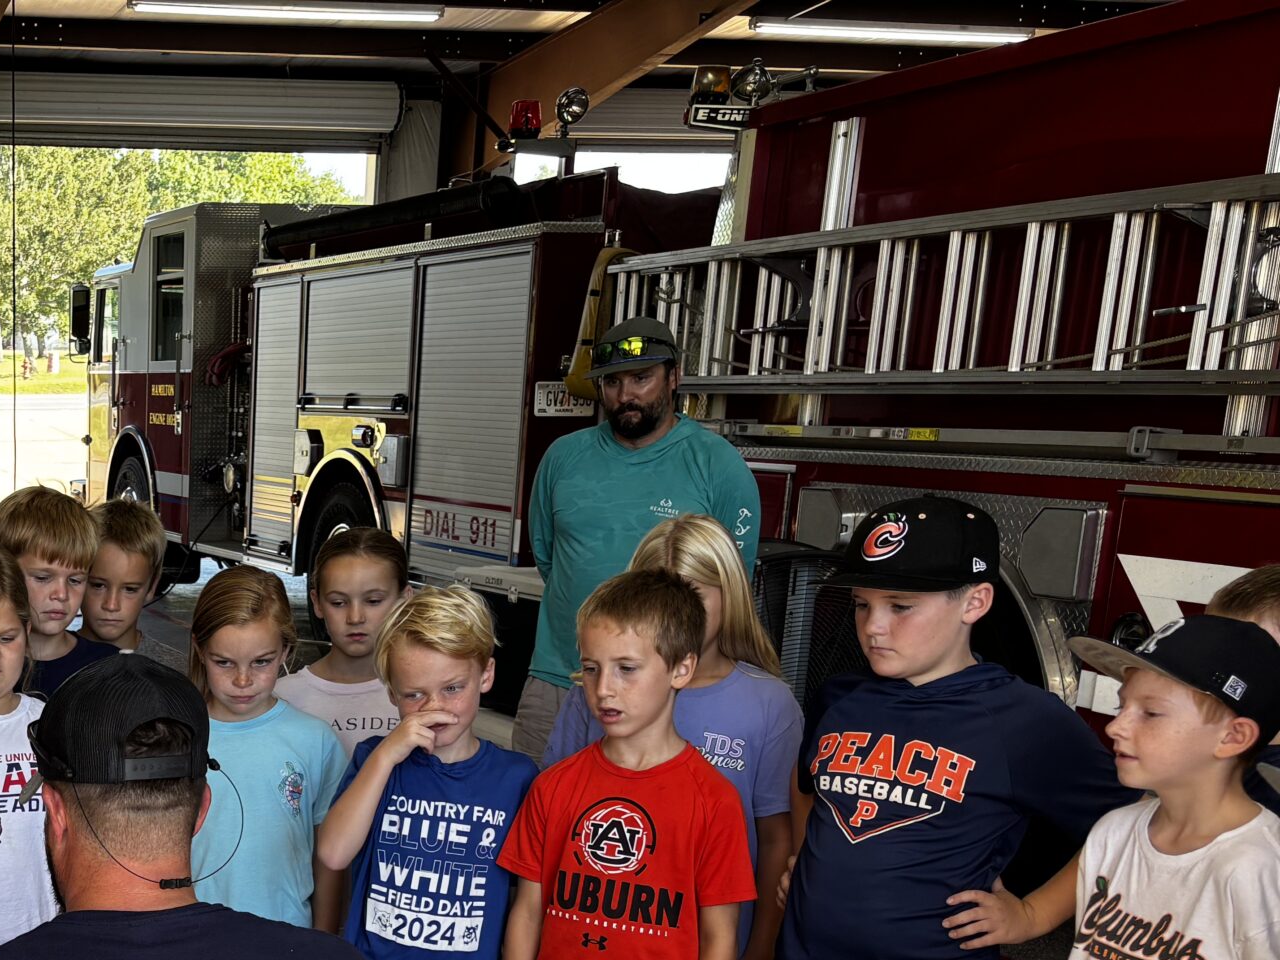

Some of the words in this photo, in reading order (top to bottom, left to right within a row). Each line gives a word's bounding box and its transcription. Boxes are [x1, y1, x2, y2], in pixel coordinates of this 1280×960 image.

[649, 505, 679, 516] REALTREE
[423, 509, 460, 541] DIAL
[469, 515, 497, 548] 911
[703, 731, 746, 758] TDS
[809, 731, 977, 804] PEACH
[819, 775, 933, 810] BASEBALL
[472, 806, 506, 827] FAIR
[849, 799, 879, 828] P
[378, 812, 472, 857] BLUE
[475, 827, 497, 860] &
[377, 848, 489, 898] WHITE
[387, 888, 434, 912] FIELD
[437, 899, 472, 917] DAY
[392, 913, 457, 946] 2024
[585, 917, 668, 937] BASKETBALL
